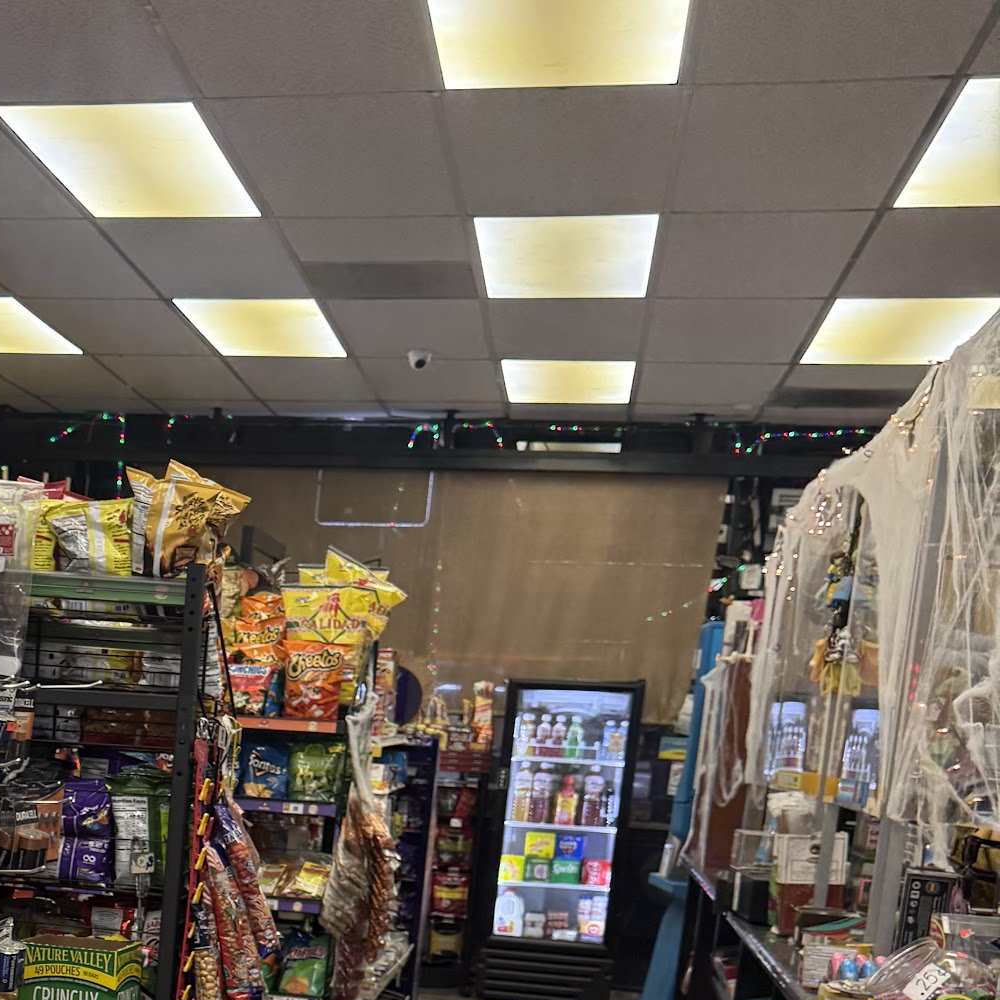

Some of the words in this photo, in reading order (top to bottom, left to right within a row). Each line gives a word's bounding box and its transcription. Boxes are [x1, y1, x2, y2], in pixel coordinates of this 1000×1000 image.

[300, 618, 360, 630] CALIDAD
[287, 650, 343, 677] Cheetos
[552, 862, 578, 875] Sprite
[24, 944, 68, 965] NATURE
[70, 949, 112, 973] VALLEY
[34, 965, 44, 975] 49
[45, 965, 81, 976] POUCHES
